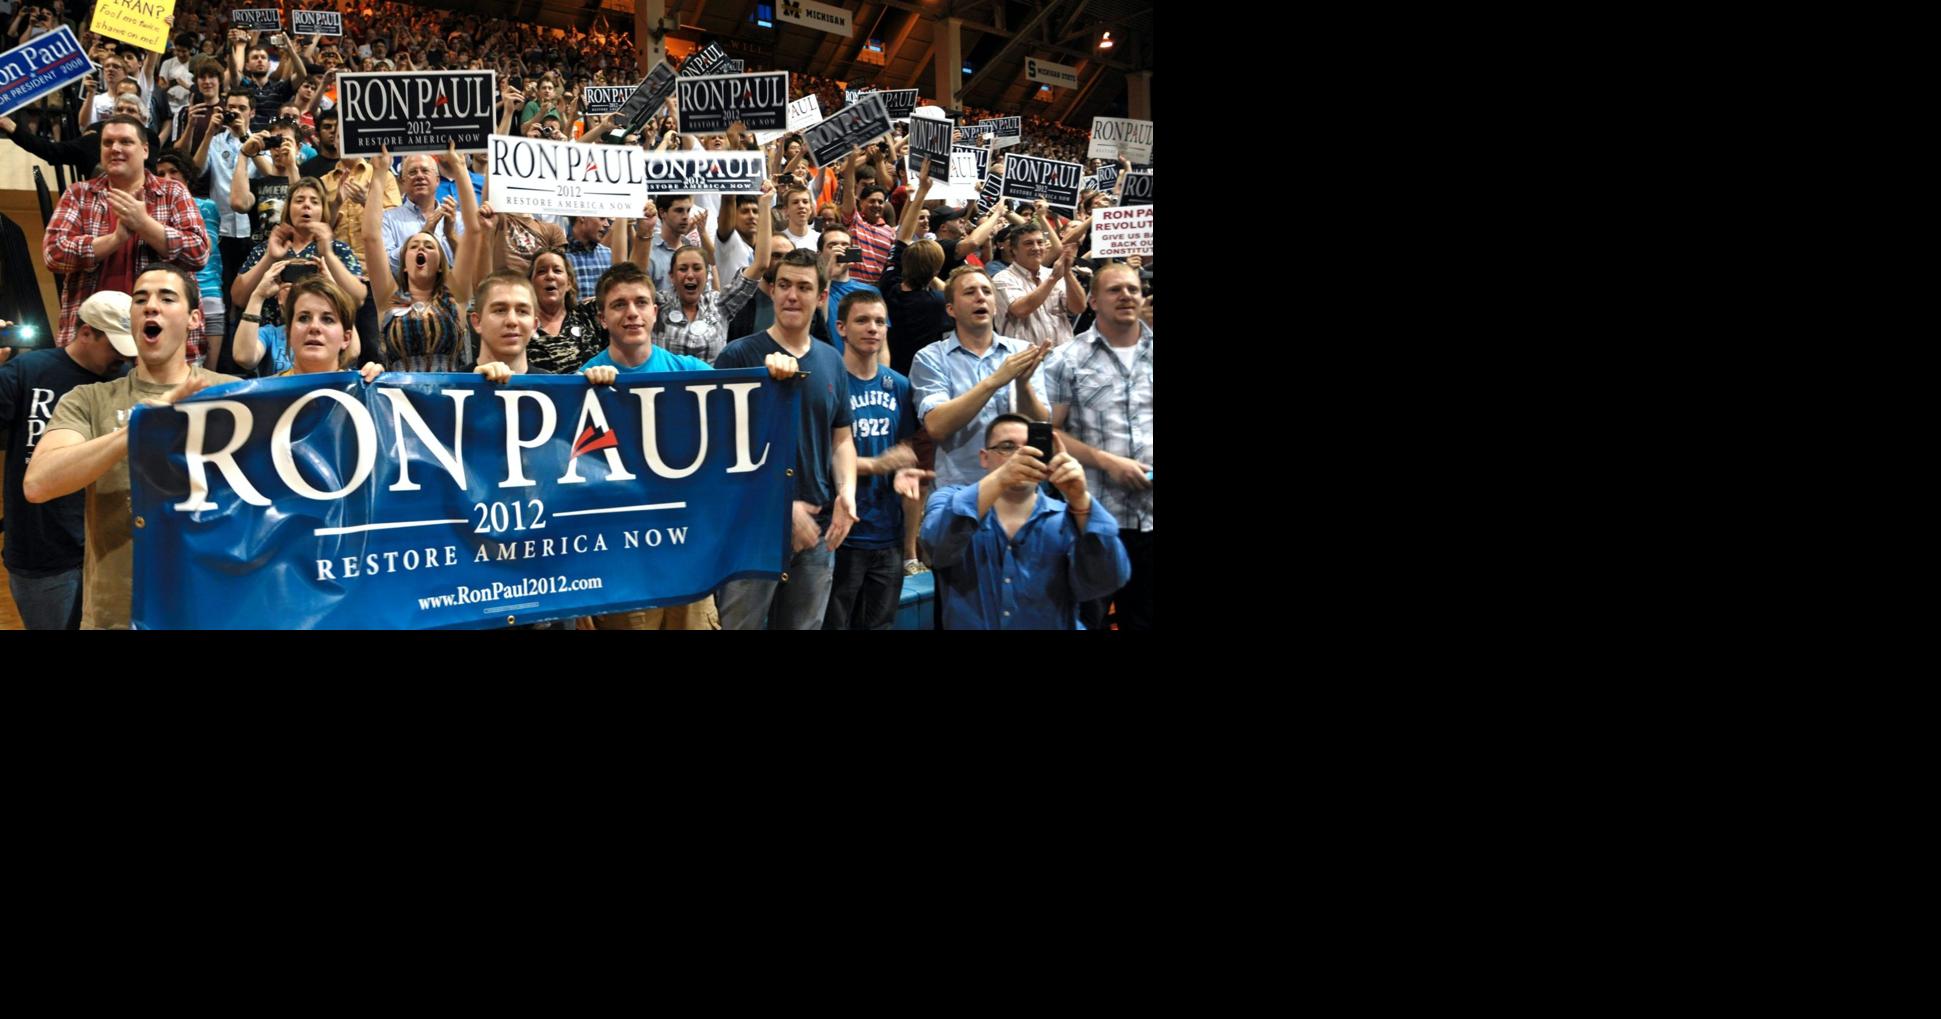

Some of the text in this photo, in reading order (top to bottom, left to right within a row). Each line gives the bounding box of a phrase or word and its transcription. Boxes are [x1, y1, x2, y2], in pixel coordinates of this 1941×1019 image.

[113, 0, 165, 19] RAN?
[235, 9, 279, 22] RON PAUL
[295, 11, 340, 26] RON PAUL
[806, 9, 845, 26] MICHIGAN
[19, 31, 77, 70] Paul
[693, 43, 724, 71] PAUL
[10, 71, 57, 97] PRESIDENT
[680, 80, 726, 112] RON
[728, 77, 784, 109] PAUL
[344, 77, 491, 122] RON PAUL
[588, 88, 637, 104] RON PAU
[885, 91, 914, 108] PAUL
[722, 109, 740, 120] 2012
[788, 96, 818, 120] AUL
[407, 120, 432, 135] 2012
[760, 118, 776, 126] NOW
[1093, 120, 1125, 141] RON
[358, 133, 481, 147] RESTORE AMERICA NOW
[910, 118, 928, 151] RON
[927, 121, 950, 157] PAUL
[491, 139, 643, 184] RON PAUL
[646, 158, 761, 181] ON PAUL
[1006, 157, 1079, 189] RON PAUL
[556, 184, 582, 198] 2012
[506, 196, 632, 210] RESTORE AMERICA NOW
[1103, 209, 1133, 220] RON
[1095, 220, 1153, 231] REVOLUT
[1102, 233, 1125, 241] GIVE
[1127, 232, 1140, 240] US
[852, 417, 890, 438] 1922
[173, 380, 771, 513] RON PAUL
[472, 498, 547, 535] 2012
[315, 526, 689, 581] RESTORE AMERICA NOW
[418, 575, 603, 611] www.RonPaul2012.com
